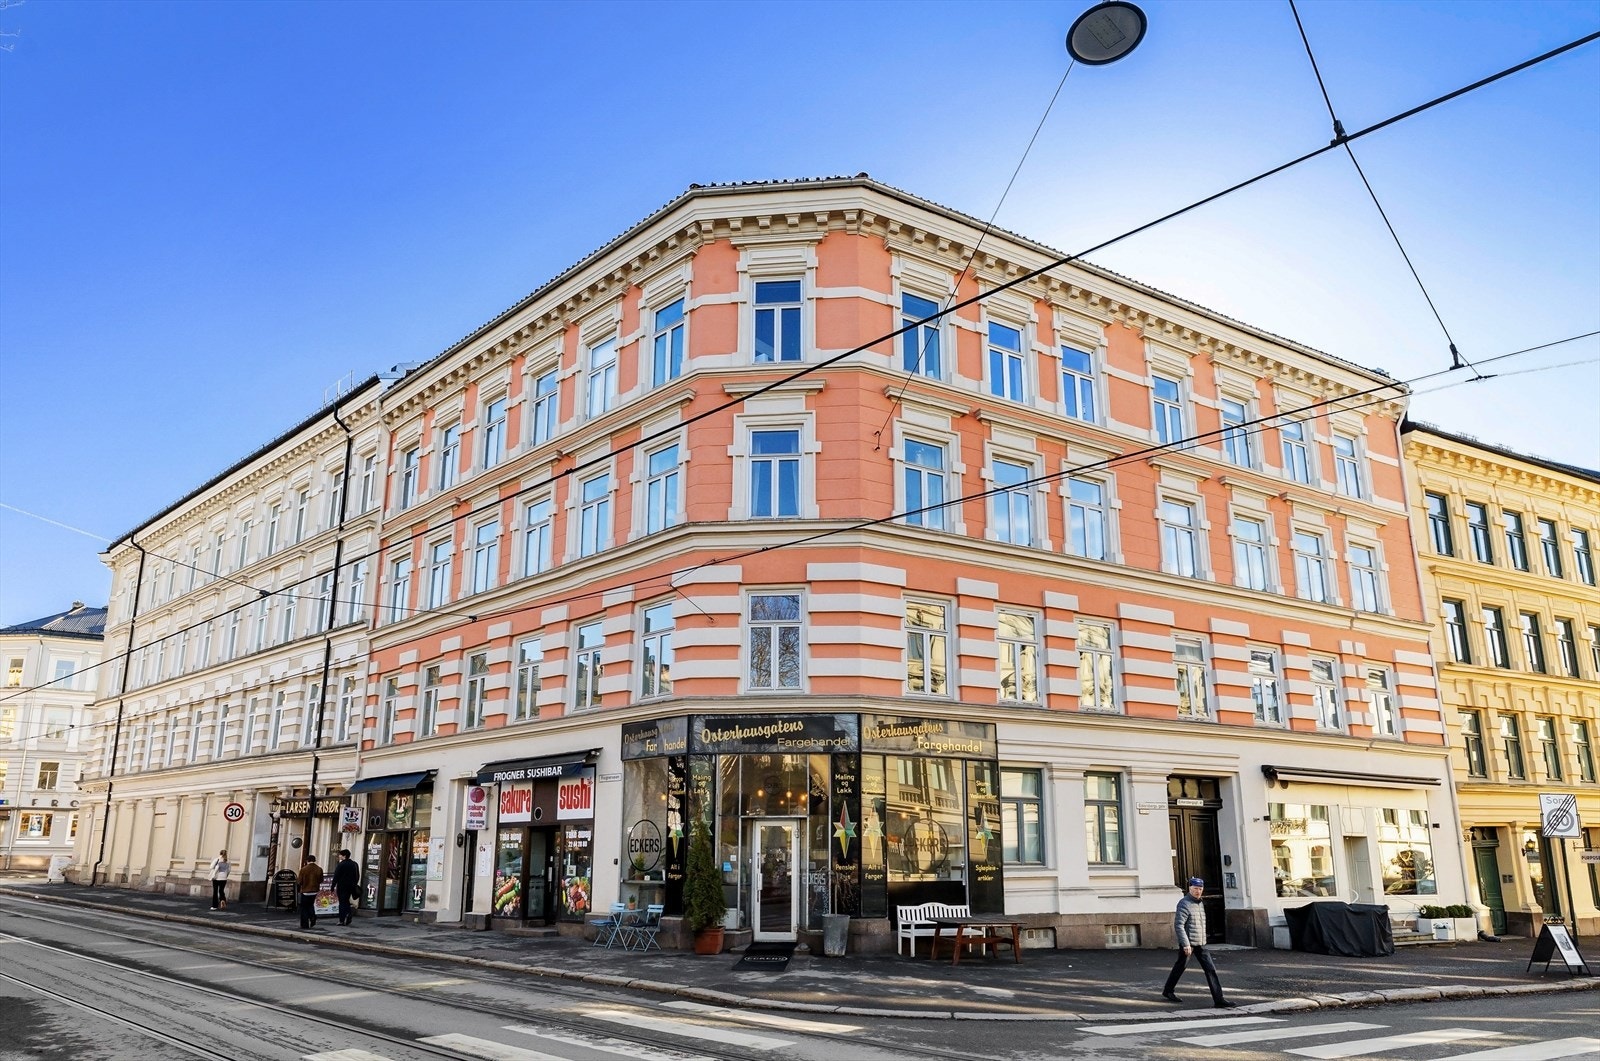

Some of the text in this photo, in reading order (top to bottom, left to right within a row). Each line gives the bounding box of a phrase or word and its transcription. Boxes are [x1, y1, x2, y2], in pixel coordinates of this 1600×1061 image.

[701, 720, 804, 744] Osterhausgatens
[863, 722, 944, 739] Osterhausgatens
[777, 737, 850, 748] Fargehandel
[917, 736, 983, 753] Fargehandel
[493, 766, 563, 781] FROGNER SUSHIBAR
[692, 774, 712, 782] Maling
[835, 774, 855, 782] Maling
[501, 785, 531, 814] sakura
[559, 778, 591, 809] sushi
[1546, 796, 1567, 804] Son
[228, 807, 241, 817] 30
[286, 801, 340, 813] LARSEN FRISØR
[630, 838, 660, 853] ECKERS
